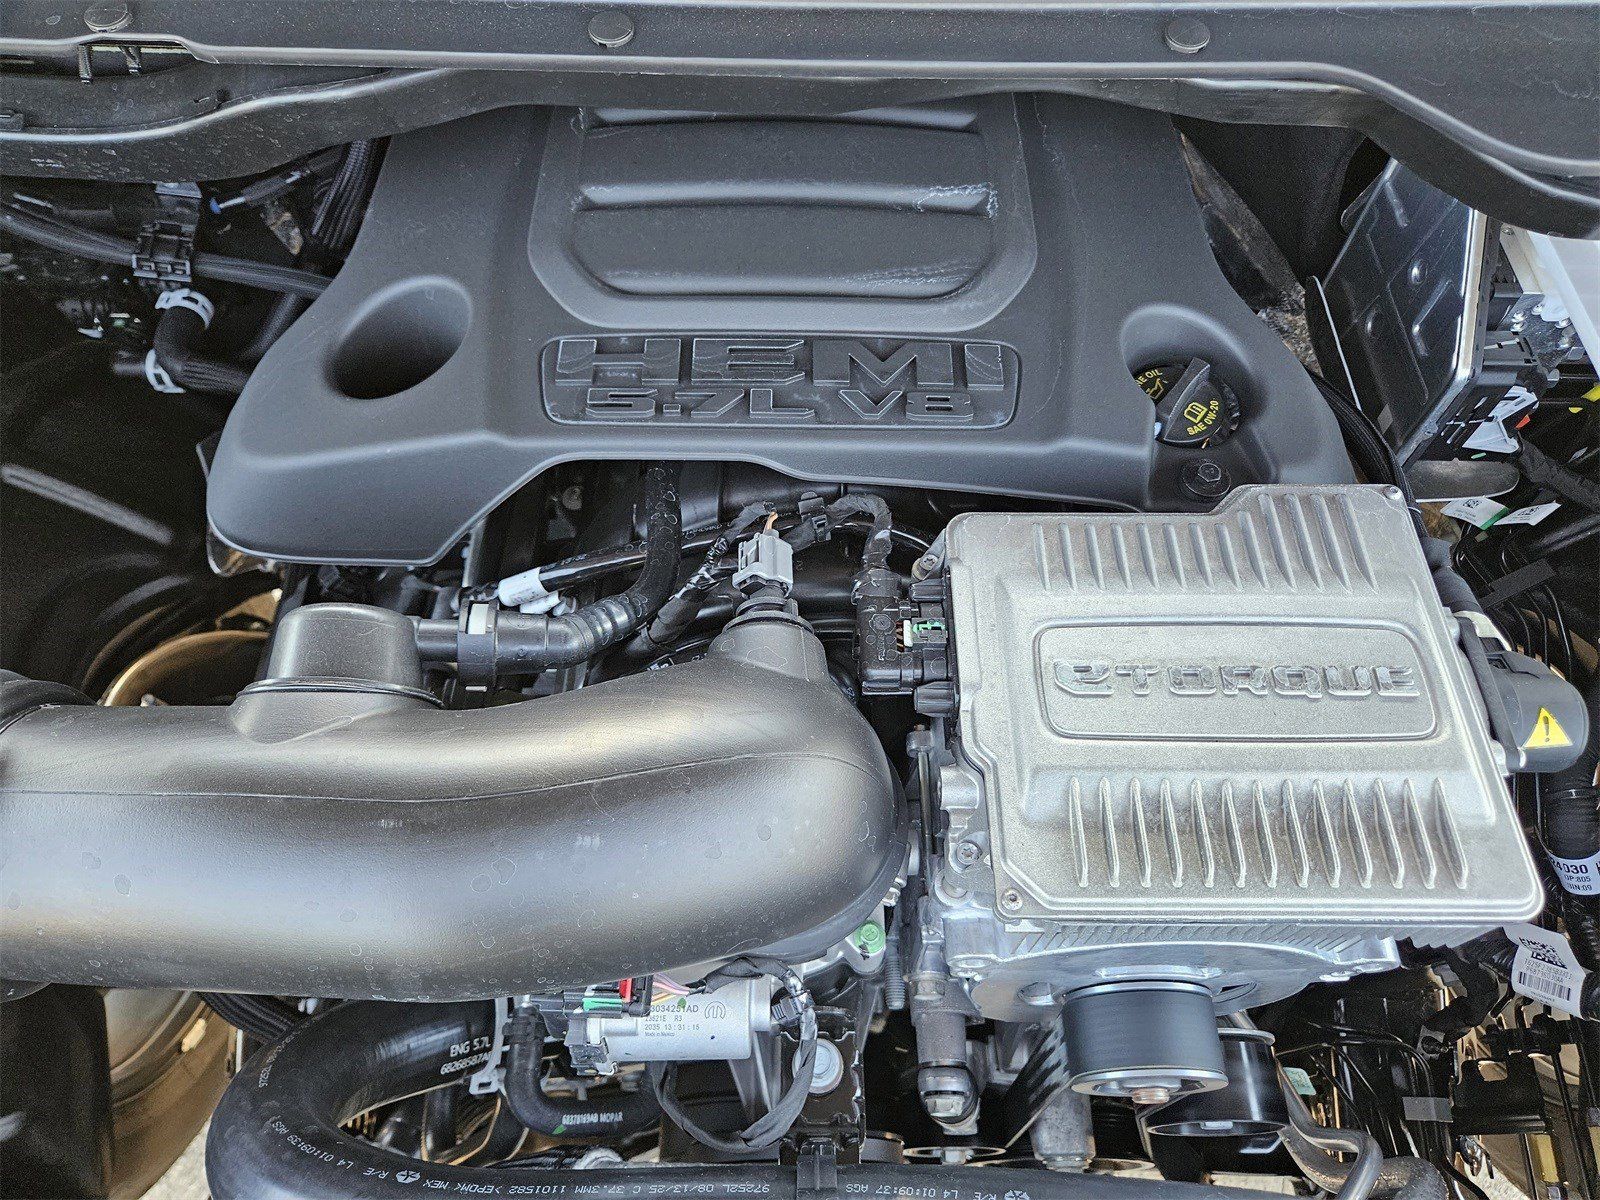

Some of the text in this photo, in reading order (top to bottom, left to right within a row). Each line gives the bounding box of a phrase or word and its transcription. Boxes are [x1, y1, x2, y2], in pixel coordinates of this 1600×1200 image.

[555, 338, 1005, 389] HEMI
[1145, 369, 1163, 378] OIL
[585, 388, 973, 421] 5.7L V8
[1186, 400, 1219, 436] SAE 0W-20
[1053, 660, 1420, 699] eTORQUE
[450, 1040, 471, 1058] ENG
[600, 1111, 624, 1122] MOPAR
[272, 1121, 290, 1134] AGS
[336, 1158, 354, 1170] L4
[362, 1167, 390, 1180] R/E
[423, 1179, 450, 1190] MEX
[508, 1185, 566, 1194] 1101582
[574, 1184, 625, 1194] 37.3MM
[649, 1184, 715, 1194] 08/13/25
[723, 1184, 770, 1193] 97252L
[845, 1184, 869, 1193] AGS
[875, 1185, 936, 1198] 01:09:37
[943, 1189, 959, 1199] L4
